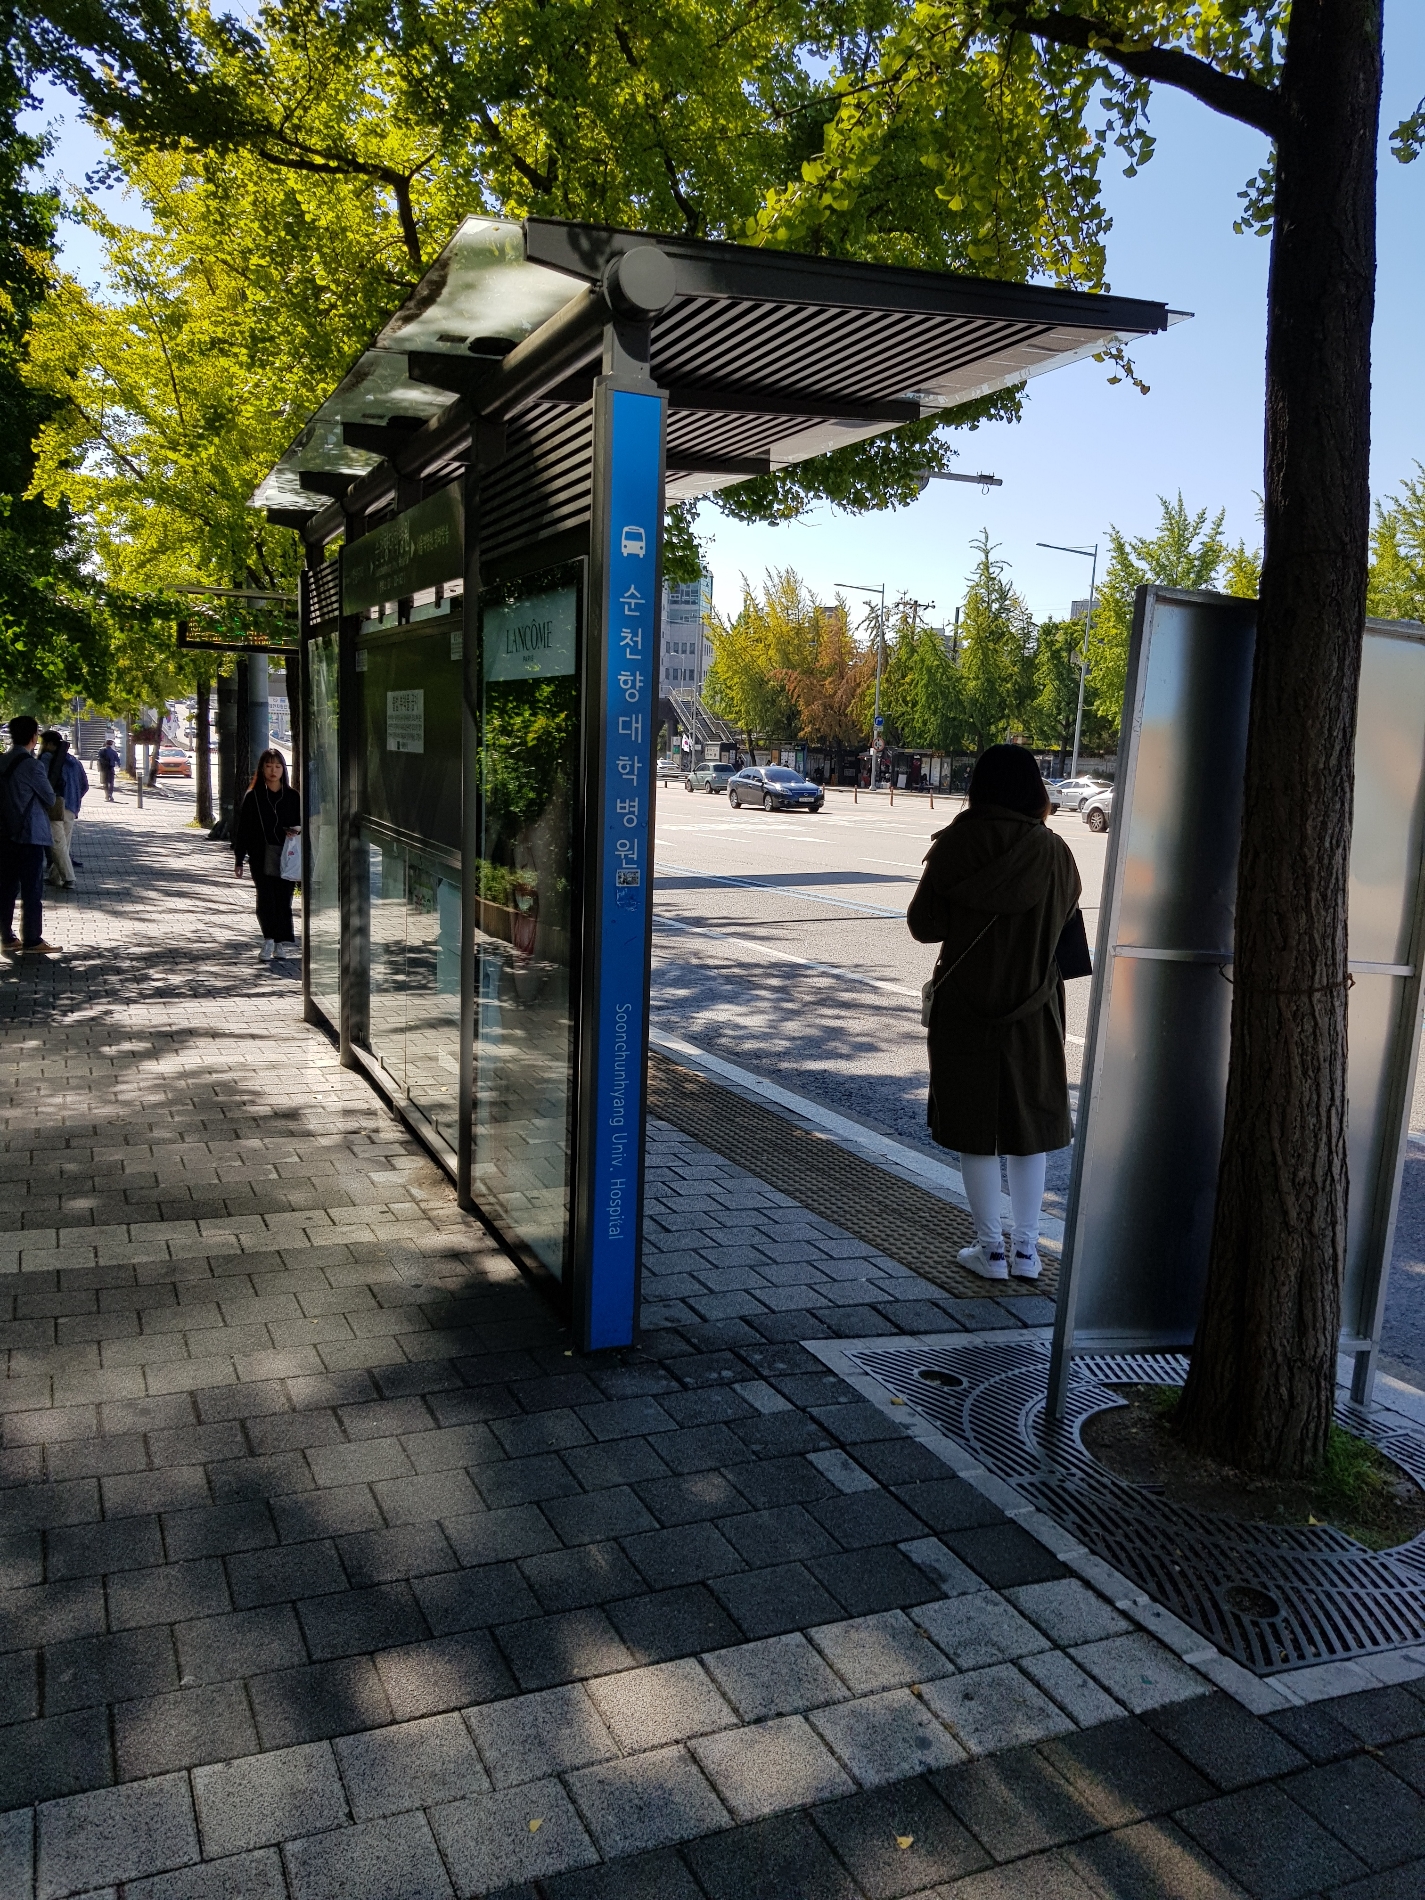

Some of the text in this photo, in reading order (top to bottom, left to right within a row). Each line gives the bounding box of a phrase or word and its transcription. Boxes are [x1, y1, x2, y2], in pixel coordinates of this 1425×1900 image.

[506, 618, 553, 653] LANCÔME
[614, 584, 646, 868] 순천향대학병원
[606, 1003, 632, 1240] Soonchunhyang Univ. Hospital
